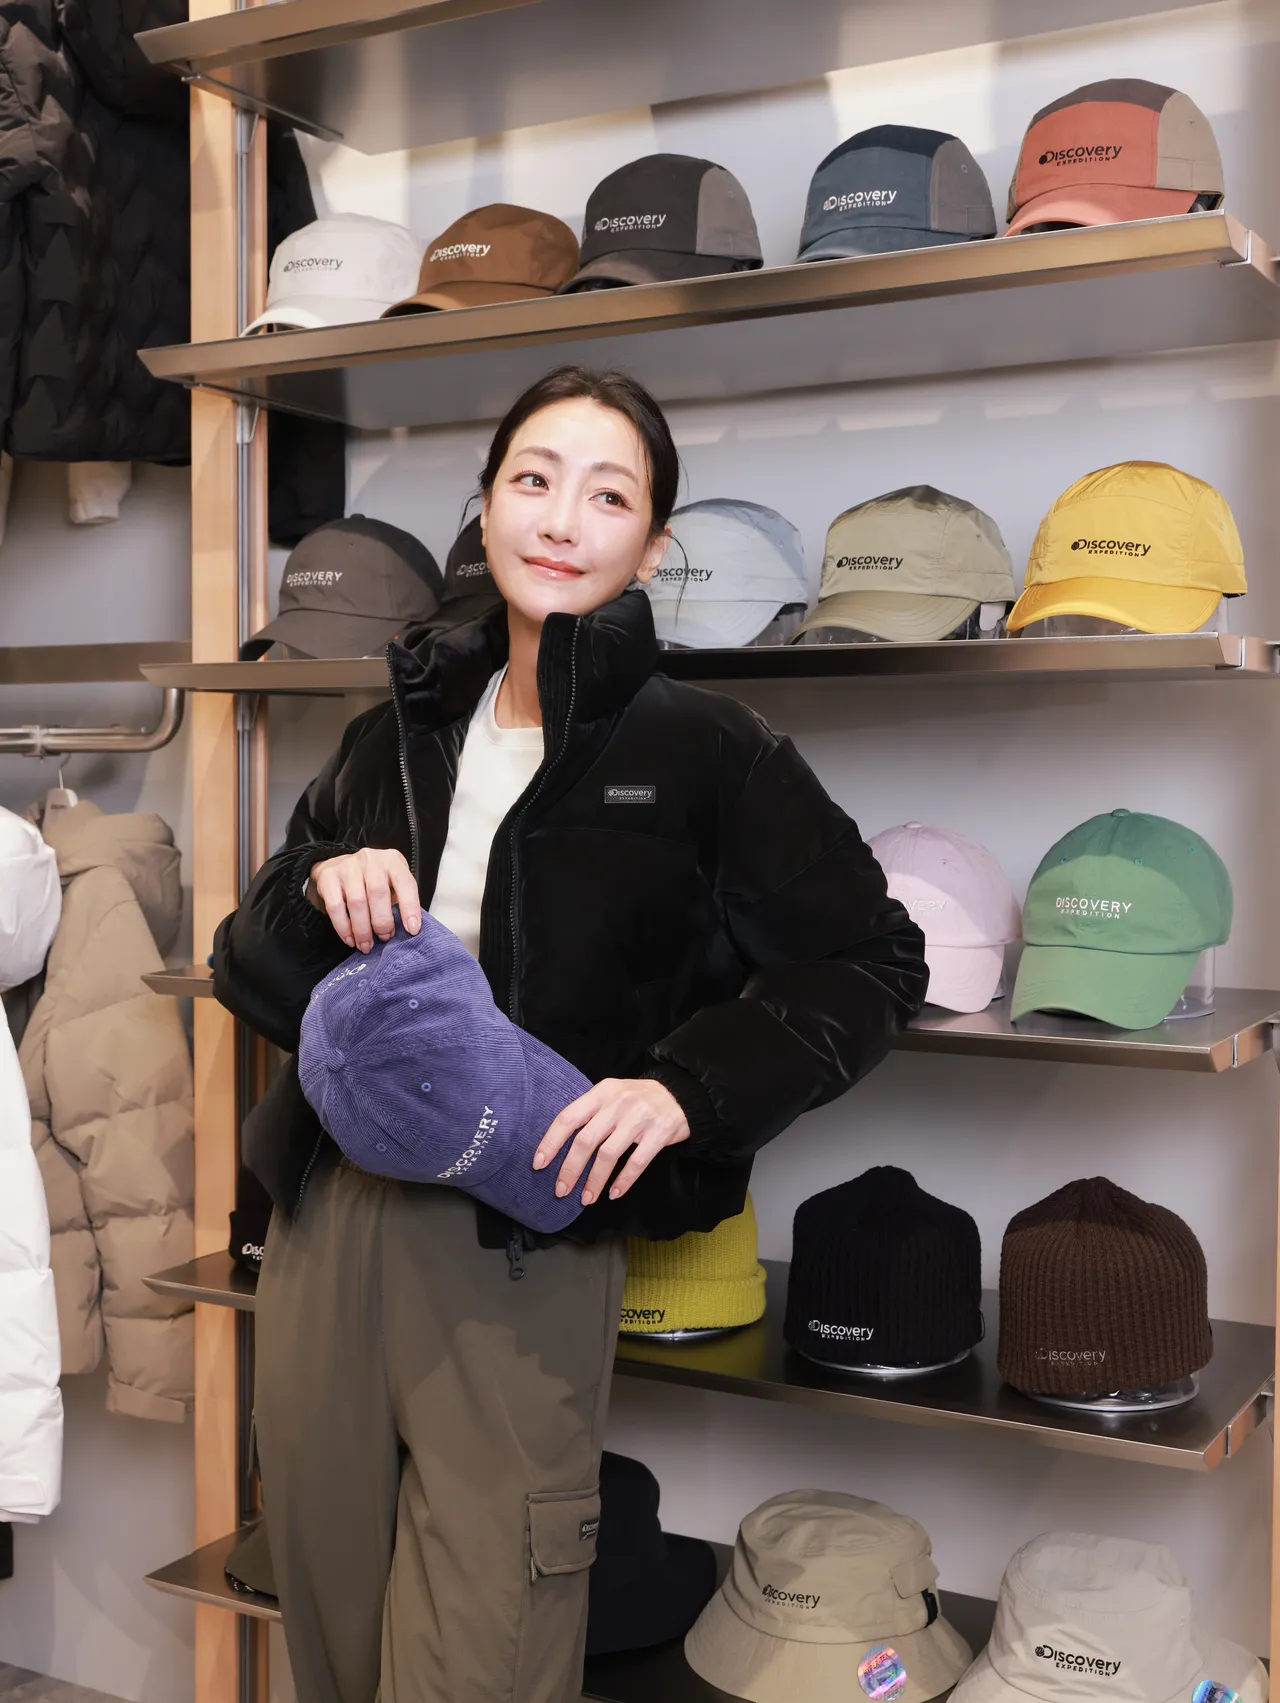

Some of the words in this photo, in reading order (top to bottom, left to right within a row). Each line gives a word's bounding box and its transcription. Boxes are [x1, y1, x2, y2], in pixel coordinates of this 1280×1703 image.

[1038, 145, 1122, 165] Discovery
[1056, 156, 1111, 167] EXPEDITION
[823, 189, 897, 211] Discovery
[839, 200, 887, 212] EXPEDITION
[594, 213, 667, 231] Discovery
[610, 224, 657, 233] EXPEDITION
[429, 243, 492, 263] Discovery
[283, 256, 344, 273] Discovery
[1071, 538, 1151, 557] Discovery
[1088, 549, 1140, 558] EXPEDITION
[836, 555, 904, 570] Discovery
[286, 571, 343, 584] DISCOVERY
[607, 788, 653, 798] Discovery
[906, 900, 948, 911] VERY
[1055, 896, 1133, 914] DISCOVERY
[1060, 908, 1120, 919] EXPEDITION
[436, 1105, 494, 1179] DISCOVERY
[808, 1319, 874, 1341] Discovery
[1035, 1347, 1106, 1363] Discovery
[762, 1584, 821, 1609] Discovery
[1034, 1644, 1122, 1675] Discovery
[1055, 1662, 1111, 1677] EXPEDITION
